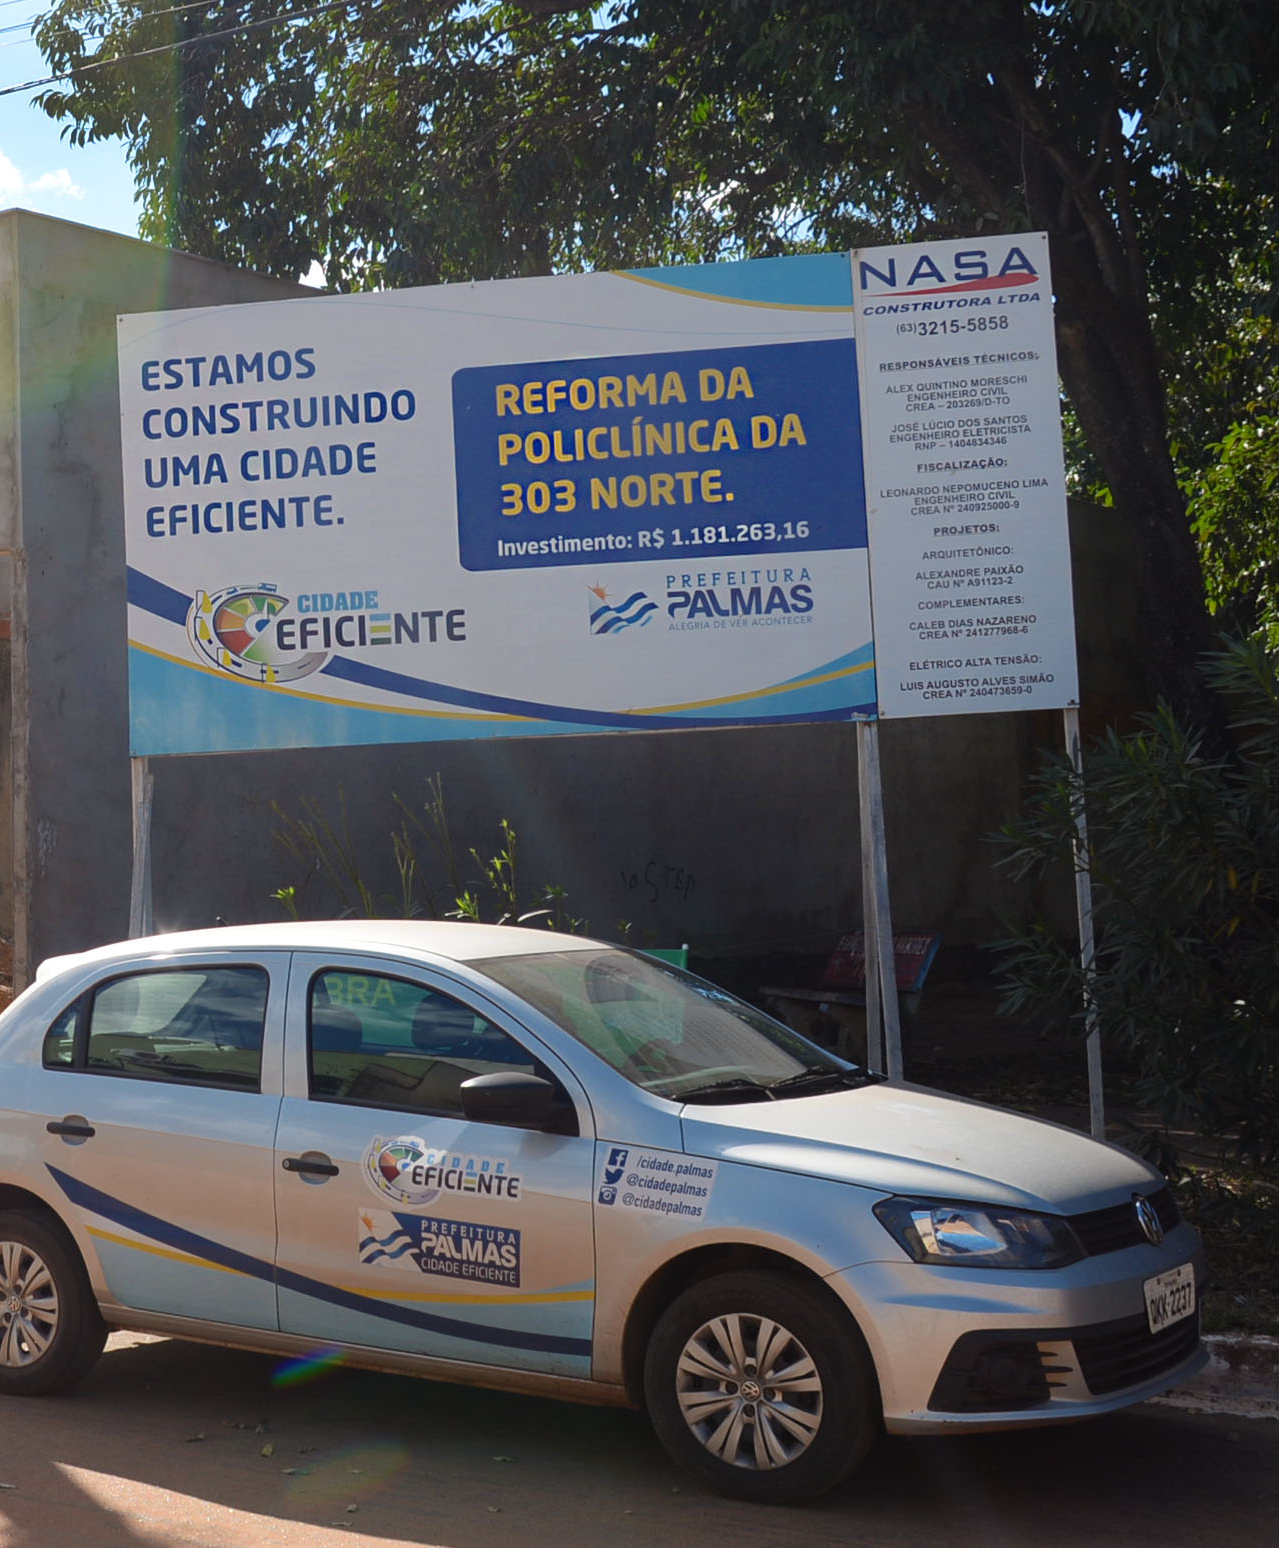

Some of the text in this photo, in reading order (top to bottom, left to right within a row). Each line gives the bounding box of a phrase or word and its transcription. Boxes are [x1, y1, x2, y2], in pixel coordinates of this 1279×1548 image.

[860, 247, 1038, 289] NASA
[863, 292, 1041, 316] CONSTRUTORA LTDA
[141, 347, 316, 391] ESTAMOS
[879, 351, 1039, 372] RESPONSÁVEIS TÉCNICOS:
[495, 365, 754, 416] REFORMA DA
[886, 375, 1027, 394] ALEX QUINTINO MORESCHI
[907, 387, 1008, 402] ENGENHEIRO CIVIL
[143, 388, 416, 440] CONSTRUINDO
[906, 402, 936, 412] CREA
[946, 396, 1010, 409] 203269/D-TO
[891, 414, 1027, 433] JOSÉ LÚCIO DOS SANTOS
[497, 412, 806, 466] POLICLÍNICA DA
[890, 425, 1031, 443] ENGENHEIRO ELETRICISTA
[914, 441, 936, 451] RNP
[144, 441, 378, 489] UMA CIDADE
[917, 458, 1008, 473] FISCALIZAÇÃO:
[500, 469, 736, 517] 303 NORTE.
[880, 478, 1048, 498] LEONARDO NEPOMUCENO LIMA
[914, 491, 1015, 505] ENGENHEIRO CIVIL
[146, 494, 345, 538] EFICIENTE.
[910, 506, 941, 516] CREA
[957, 501, 1020, 513] 240925000-9
[497, 520, 810, 558] Investimento: R$ 1.181.263,16
[934, 524, 1000, 536] PROJETOS:
[922, 546, 1014, 560] ARQUITETÔNICO:
[666, 568, 811, 588] PREFEITURA
[915, 565, 1024, 580] ALEXANDRE PAIXÃO
[927, 580, 950, 589] CAU
[967, 576, 1013, 586] A91123-2
[297, 589, 379, 613] CIDADE
[667, 584, 813, 618] PALMAS
[918, 596, 1025, 610] COMPLEMENTARES:
[276, 609, 466, 650] EFICIENTE
[669, 616, 813, 631] ALEGRIA DE VER ACONTECER
[909, 615, 1037, 630] CALEB DIAS NAZARENO
[919, 630, 949, 640] CREA
[909, 654, 1042, 671] ELÉTRICO ALTA TENSÃO:
[900, 673, 1054, 692] LUIS AUGUSTO ALVES SIMÃO
[922, 690, 953, 700] CREA
[426, 1152, 506, 1174] CIDADE
[636, 1156, 714, 1180] /cidade.palmas
[411, 1165, 521, 1199] EFICIENTE
[626, 1174, 708, 1199] @cidadepalmas
[622, 1192, 703, 1217] @cidadepalmas
[421, 1219, 516, 1245] PREFEITURA
[421, 1232, 517, 1268] PALMAS
[421, 1257, 516, 1284] CIDADE EFICIENTE
